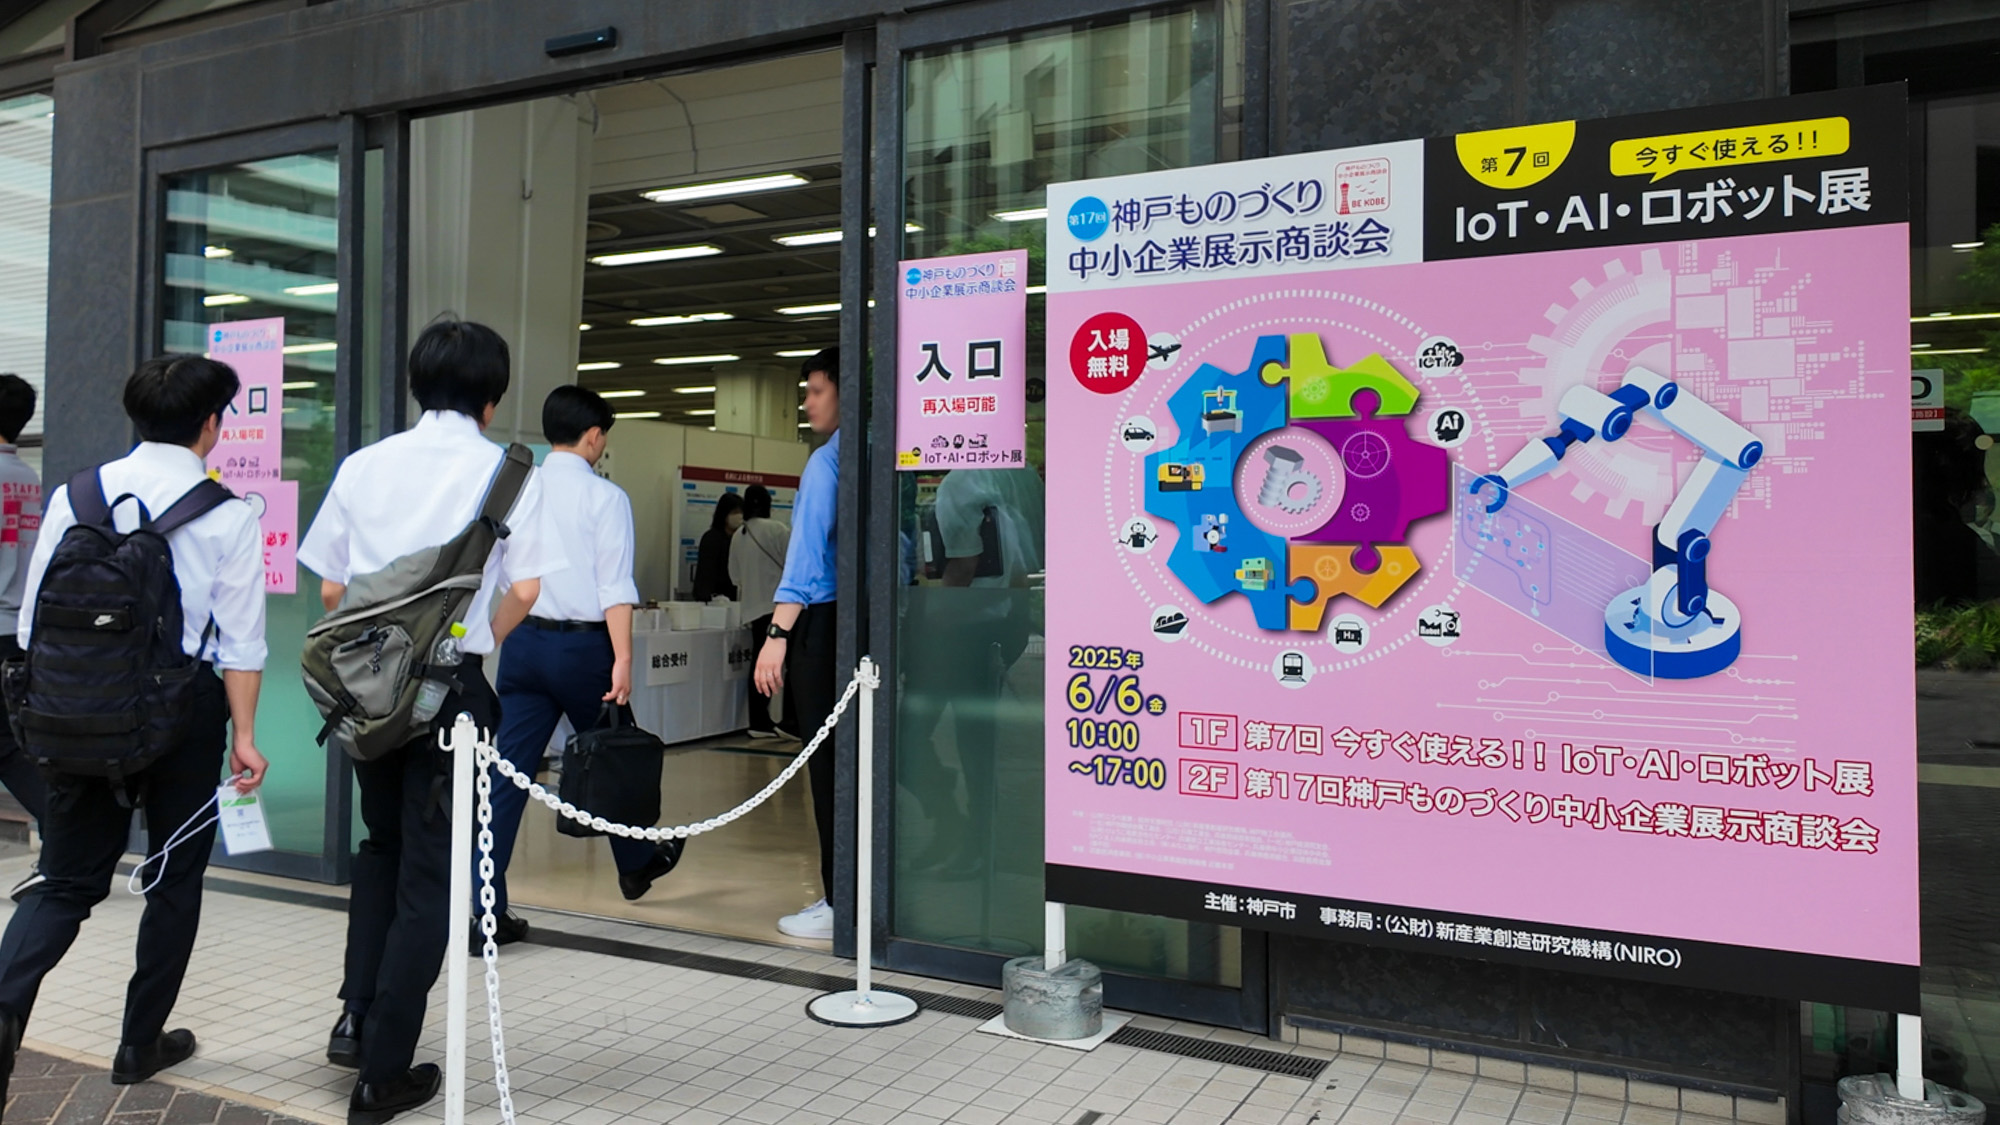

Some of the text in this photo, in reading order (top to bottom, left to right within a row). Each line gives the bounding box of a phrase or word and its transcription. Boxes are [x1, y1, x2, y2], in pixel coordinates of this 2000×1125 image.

[1480, 146, 1550, 176] 第7回
[1635, 130, 1818, 168] 今すぐ使える!!
[1111, 178, 1324, 233] 神戸ものづくり
[1351, 196, 1386, 208] BE KOBE
[1455, 167, 1872, 243] IoT・AI・ロボット展
[1068, 217, 1391, 280] 中小企業展示商談会
[1087, 328, 1130, 352] 入場
[915, 340, 1002, 384] 入口
[1087, 355, 1130, 379] 無料
[922, 397, 996, 414] 再入場可能
[652, 651, 688, 669] 総合受付
[1069, 644, 1144, 670] 2025年
[1067, 718, 1139, 752] 10:00
[1190, 717, 1229, 746] 1F
[1244, 720, 1324, 754] 第7回
[1562, 743, 1874, 797] IoT・AI・ロボット展
[1188, 763, 1229, 792] 2F
[1244, 768, 1880, 855] 第17回神戸ものづくり中小企業展示商談会
